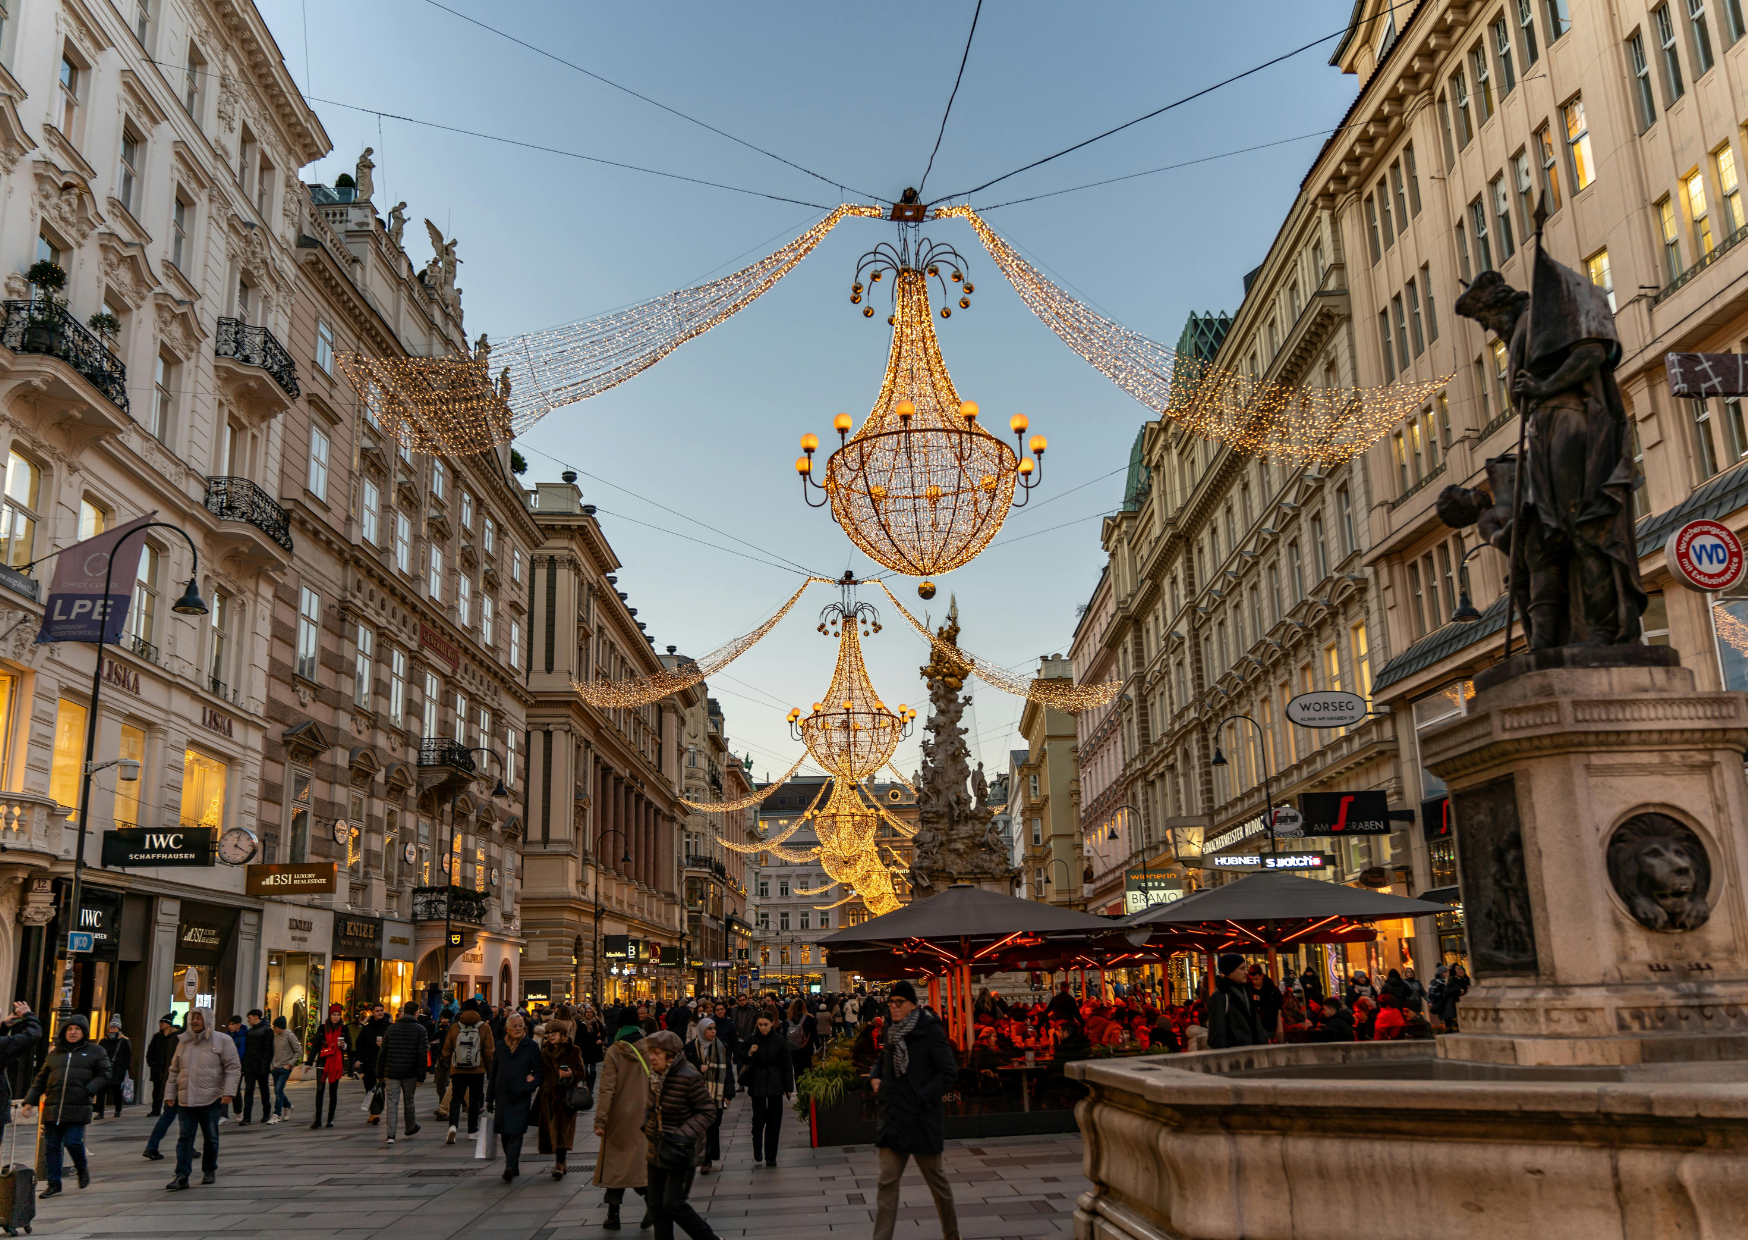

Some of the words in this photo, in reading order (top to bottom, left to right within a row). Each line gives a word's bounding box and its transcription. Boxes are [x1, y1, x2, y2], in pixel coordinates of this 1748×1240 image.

[1678, 525, 1739, 553] Versicherungsdienst
[1681, 558, 1693, 572] mit
[1691, 557, 1739, 585] Exklusivservice
[89, 581, 119, 589] CENER
[52, 599, 114, 621] LPE
[99, 656, 140, 695] LISKA
[1299, 701, 1355, 712] WORSEG
[202, 706, 233, 738] LISKA
[1313, 823, 1330, 832] AM
[1344, 820, 1384, 831] GRABEN
[143, 833, 184, 850] IWC
[37, 879, 47, 888] 12
[273, 875, 292, 885] 3SI
[1132, 892, 1178, 904] BRAMO
[80, 909, 102, 928] IWC
[346, 921, 374, 939] KNIZE
